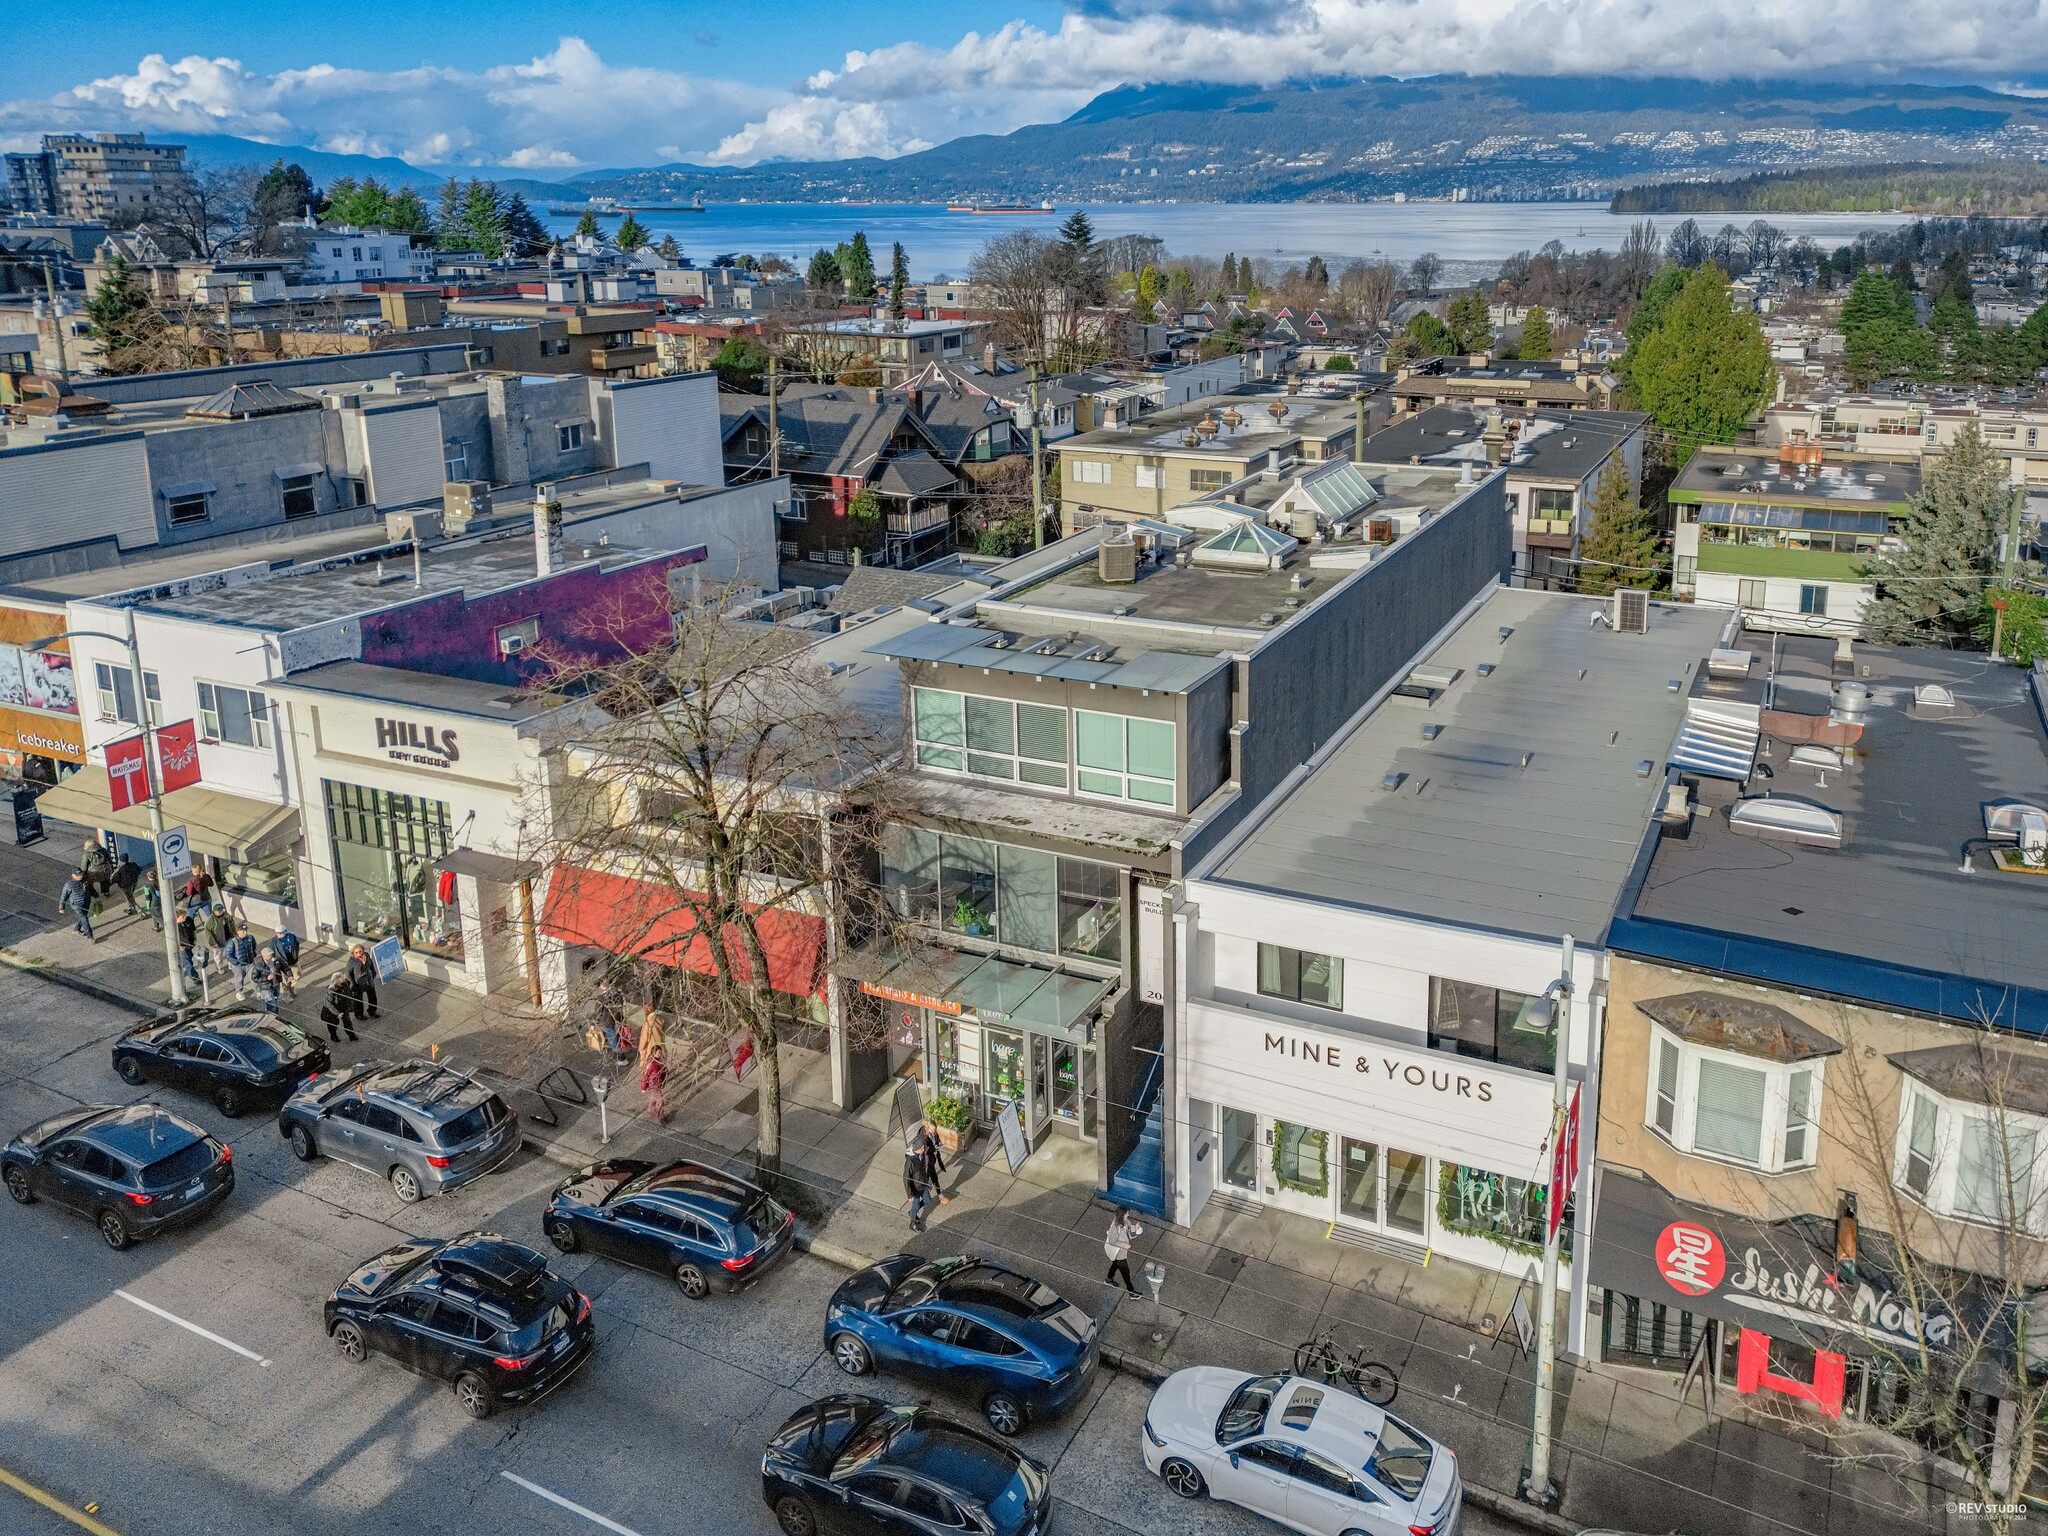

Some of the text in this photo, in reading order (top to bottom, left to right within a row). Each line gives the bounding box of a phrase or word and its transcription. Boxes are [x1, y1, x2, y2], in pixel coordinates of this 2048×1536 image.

[17, 729, 80, 755] icebreaker
[375, 717, 459, 761] HILLS
[112, 761, 140, 775] #KITSMAS
[1147, 990, 1164, 1001] 20
[1265, 1032, 1493, 1102] MINE & YOURS
[1731, 1247, 1951, 1347] Sushi Nova
